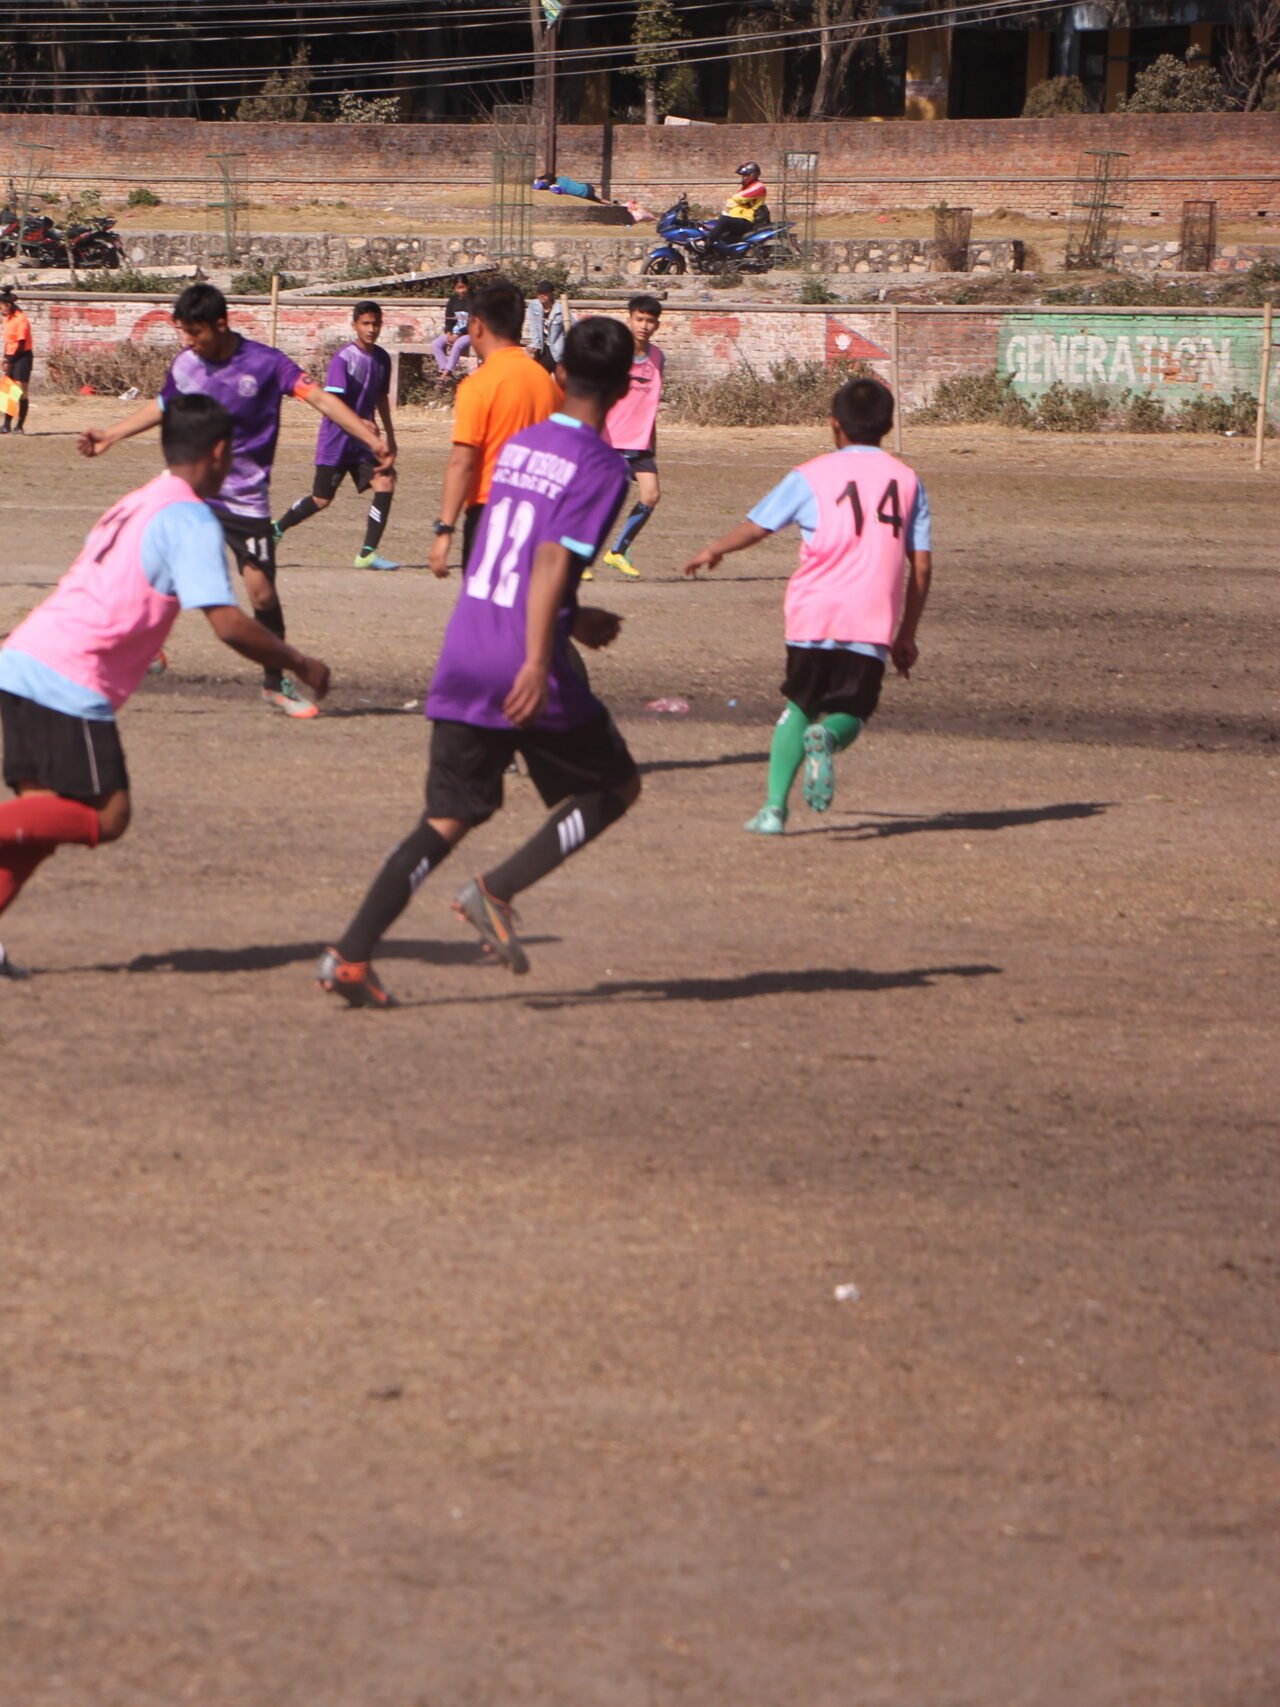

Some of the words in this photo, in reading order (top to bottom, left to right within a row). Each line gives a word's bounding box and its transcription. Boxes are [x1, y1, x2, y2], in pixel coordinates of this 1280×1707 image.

[1005, 334, 1232, 384] GENERATION
[835, 478, 904, 539] 14
[466, 496, 536, 608] 12
